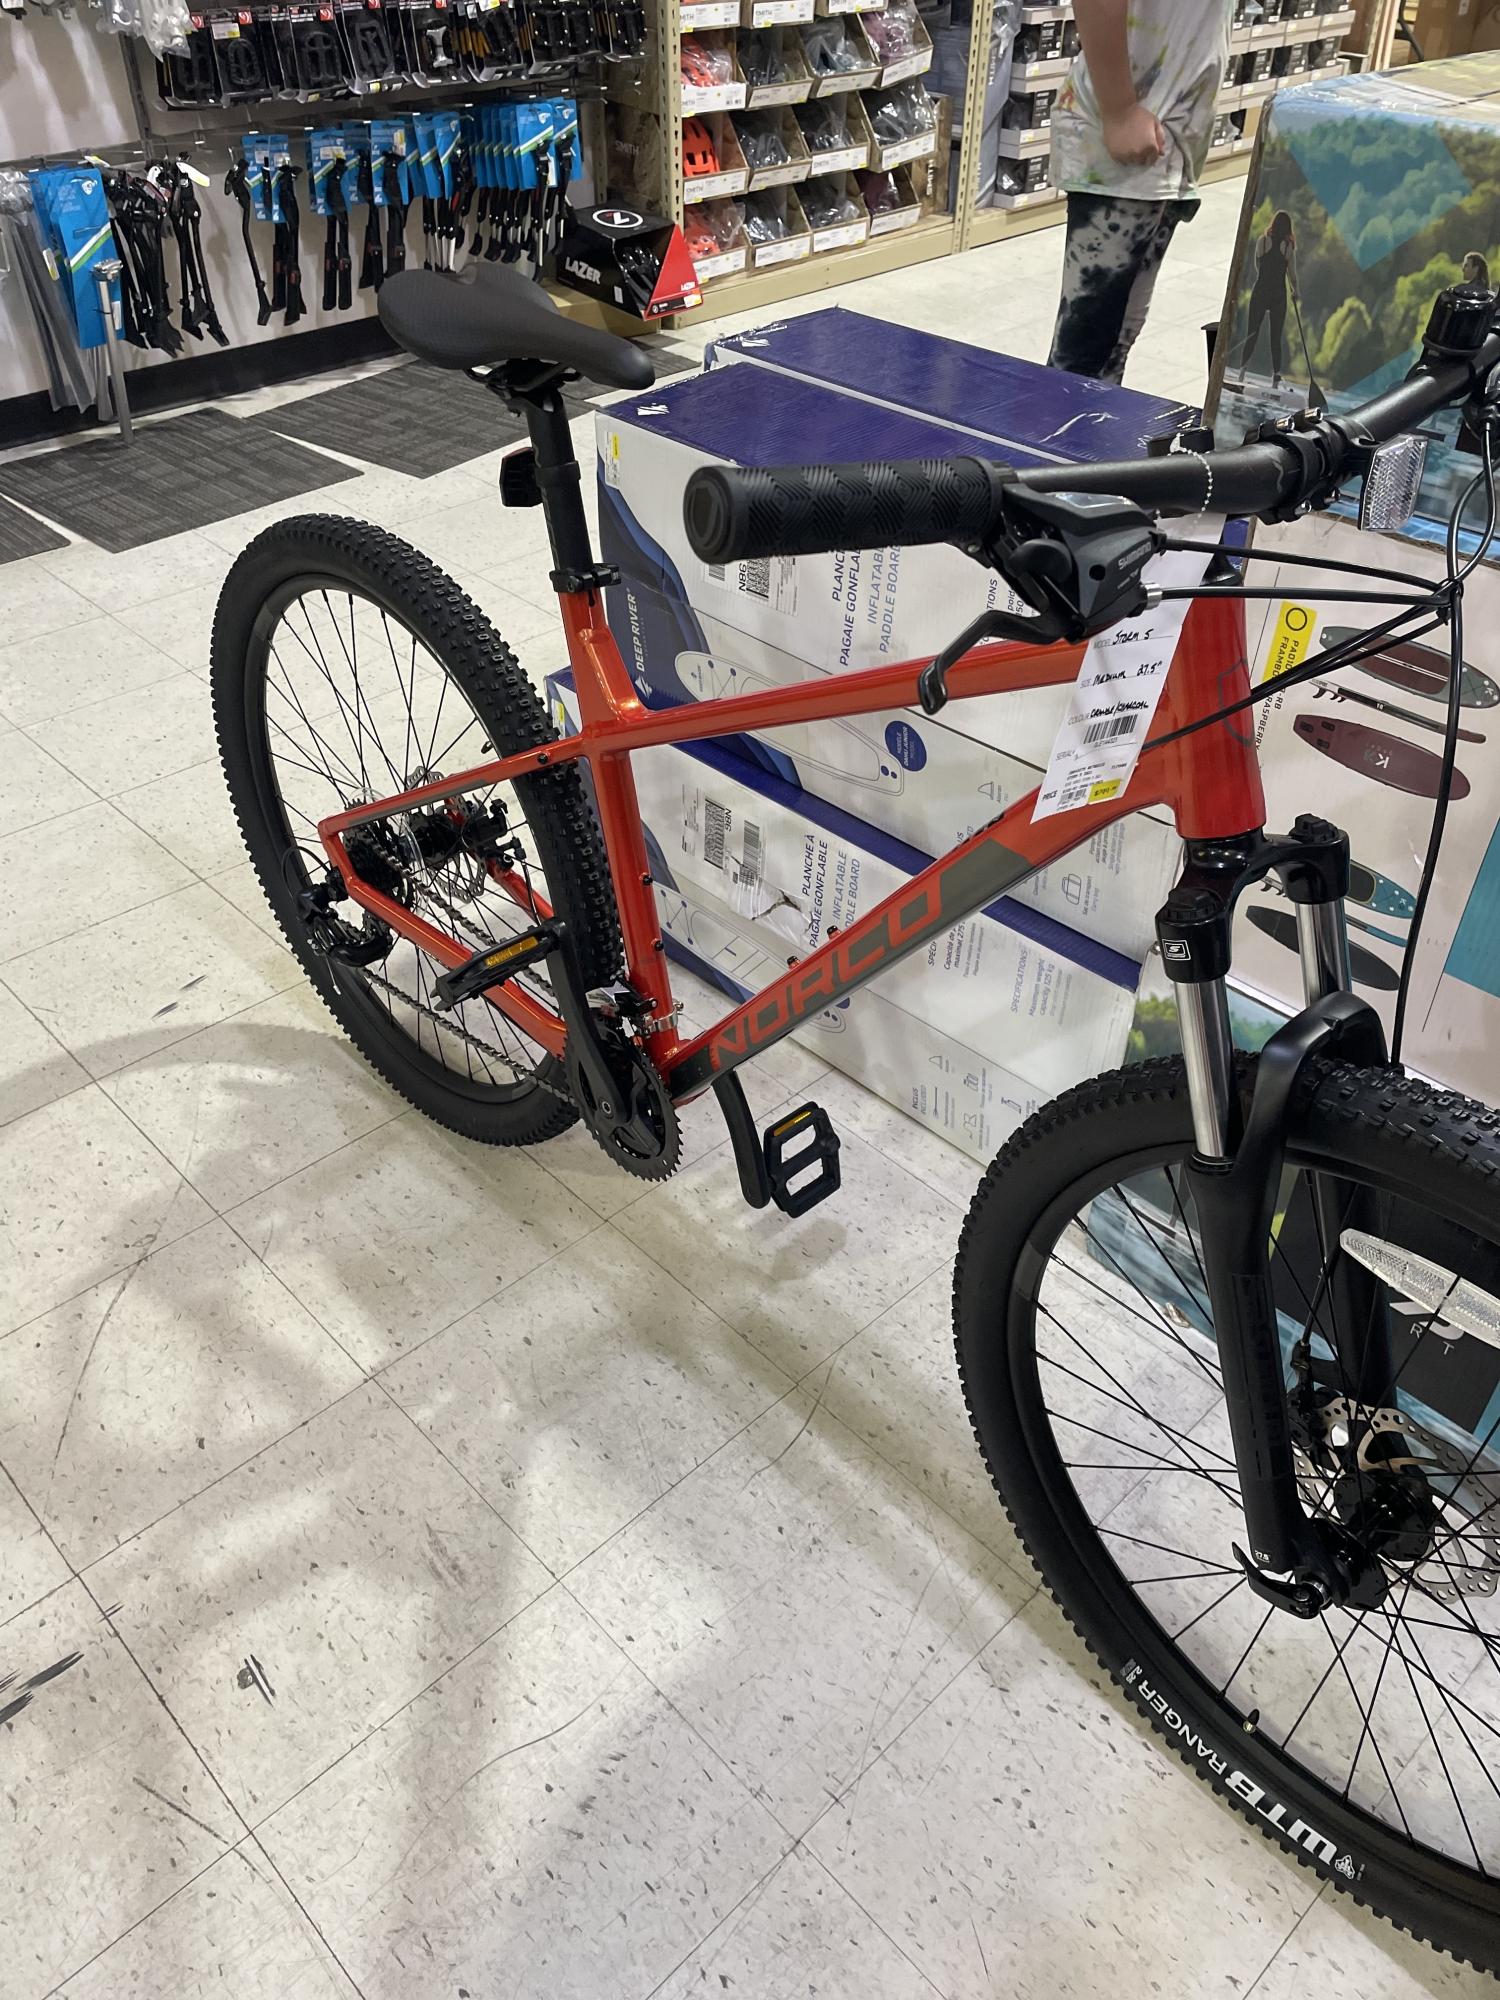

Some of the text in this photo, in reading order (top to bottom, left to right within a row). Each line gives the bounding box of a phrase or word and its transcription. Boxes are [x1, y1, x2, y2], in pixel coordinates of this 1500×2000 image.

[565, 257, 601, 284] LAZER
[739, 563, 748, 592] N86
[1117, 541, 1151, 570] SHIMANO
[867, 547, 884, 624] INFLATABL
[1008, 590, 1016, 611] poid
[628, 594, 641, 637] RIVER
[879, 596, 896, 653] PADDLE
[1144, 628, 1154, 640] 5
[632, 639, 645, 672] DEEP
[840, 615, 854, 667] PAGAIE
[1042, 790, 1058, 801] PRICE
[802, 847, 815, 896] PLANCHE
[809, 840, 828, 948] PAGAIE GONFLABLE
[832, 850, 848, 920] INFLATABLE
[849, 858, 861, 896] BOARD
[709, 873, 942, 1071] NORCO
[1011, 949, 1028, 1013] SPECIFICATIONS
[1138, 1680, 1338, 1865] WTB RANGER
